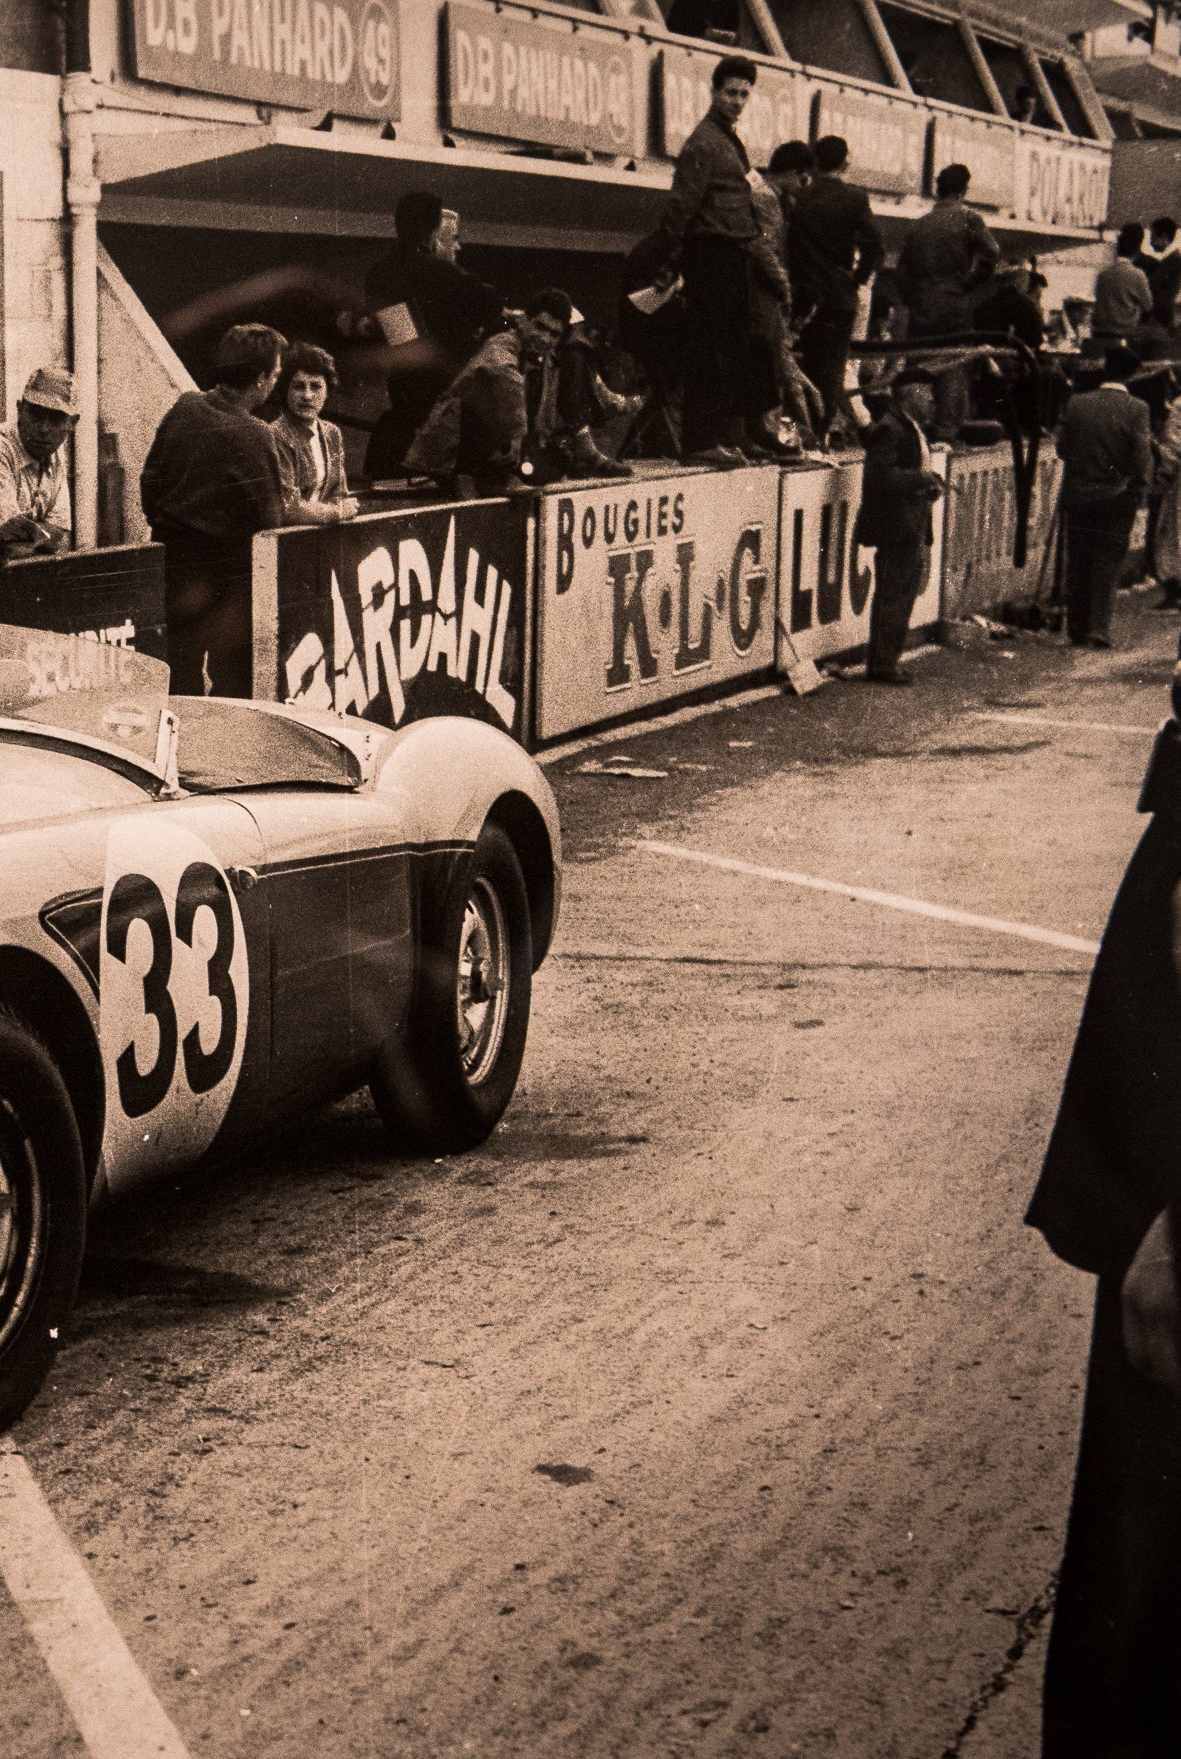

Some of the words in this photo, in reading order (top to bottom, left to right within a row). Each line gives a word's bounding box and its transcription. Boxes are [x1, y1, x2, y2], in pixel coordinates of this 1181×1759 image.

[212, 0, 355, 85] PANHARD
[501, 41, 603, 127] PANHARD
[556, 493, 686, 596] BOUGIES
[285, 514, 516, 729] BARDAHL
[106, 861, 238, 1119] 33
